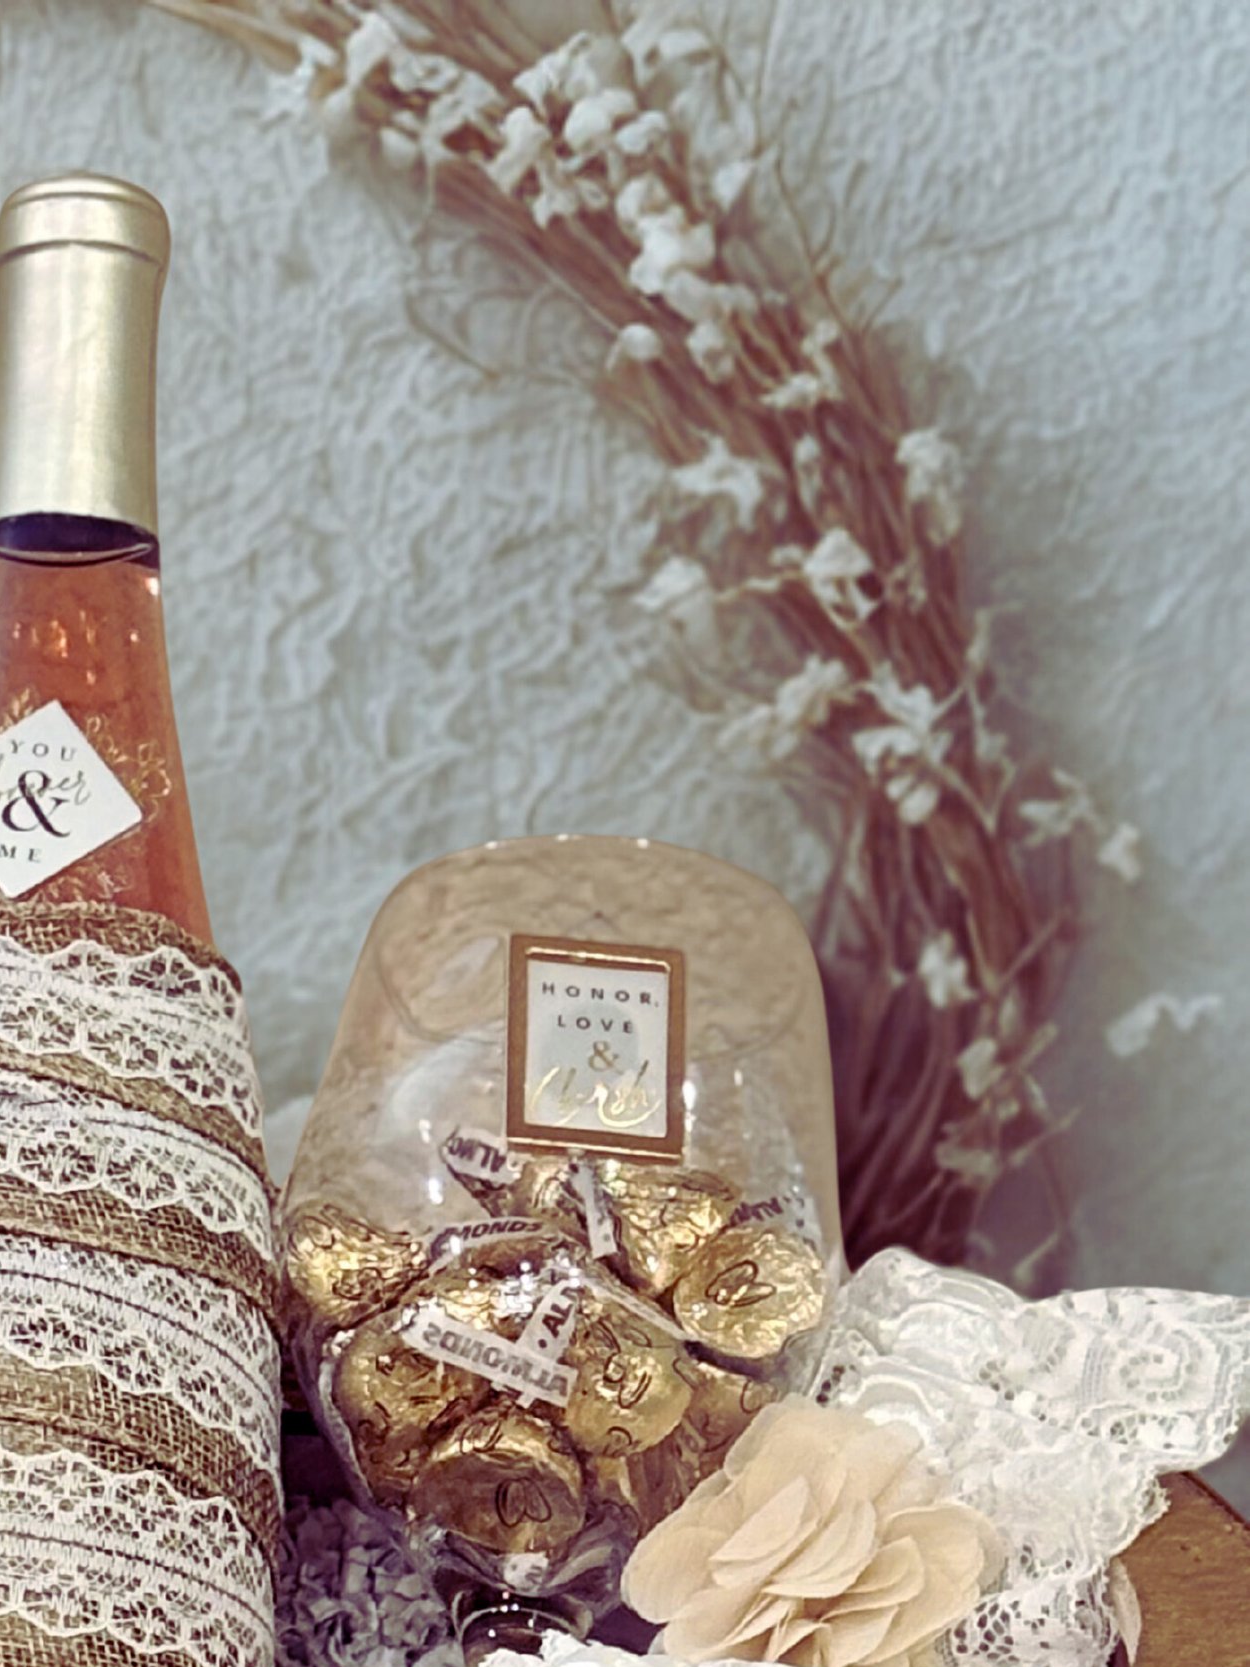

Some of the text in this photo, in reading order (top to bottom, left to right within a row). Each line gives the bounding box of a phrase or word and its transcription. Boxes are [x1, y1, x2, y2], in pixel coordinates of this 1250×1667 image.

[10, 739, 78, 761] YOU
[1, 769, 71, 838] &
[0, 844, 42, 863] ME
[557, 1014, 634, 1034] LOVE
[588, 1040, 624, 1075] &
